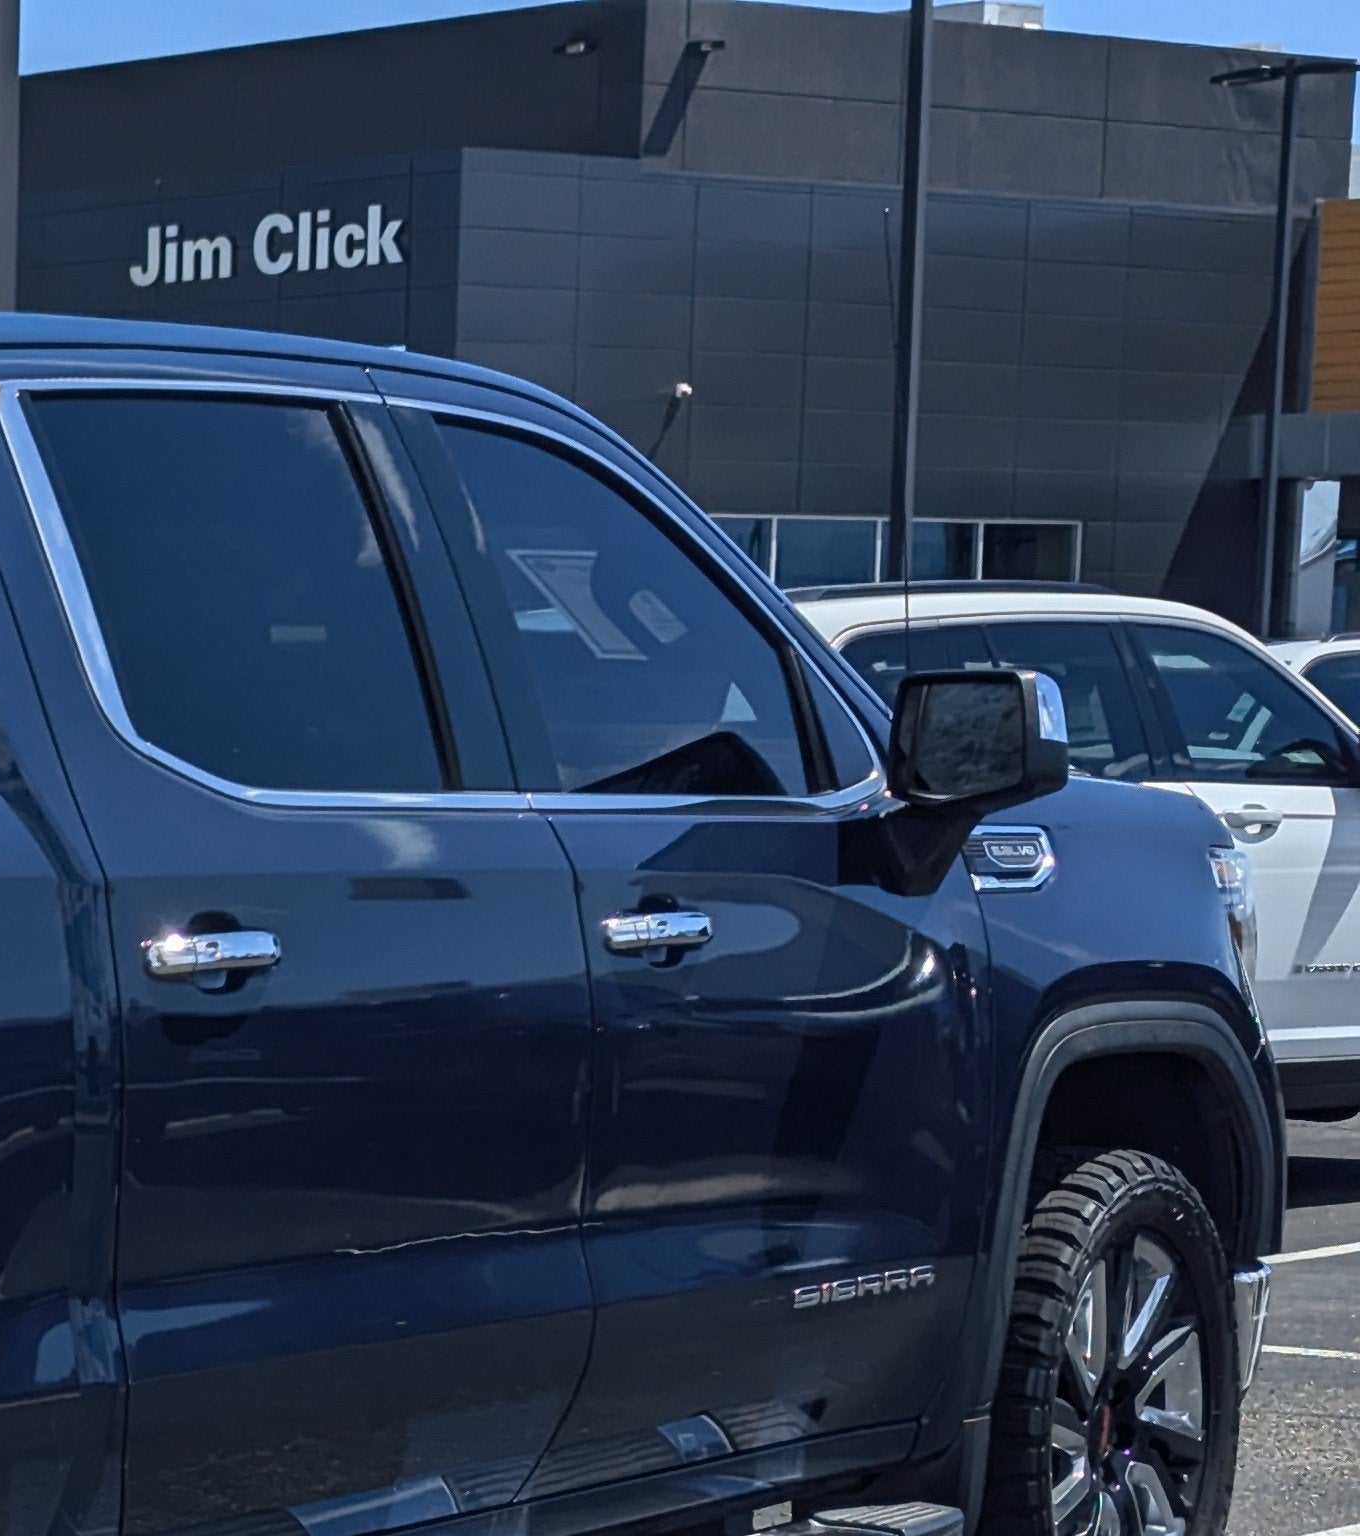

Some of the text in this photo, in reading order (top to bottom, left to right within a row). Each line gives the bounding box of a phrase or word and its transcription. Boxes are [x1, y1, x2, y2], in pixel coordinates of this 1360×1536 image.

[129, 204, 405, 288] Jim Click
[793, 1264, 936, 1309] SIERRA
